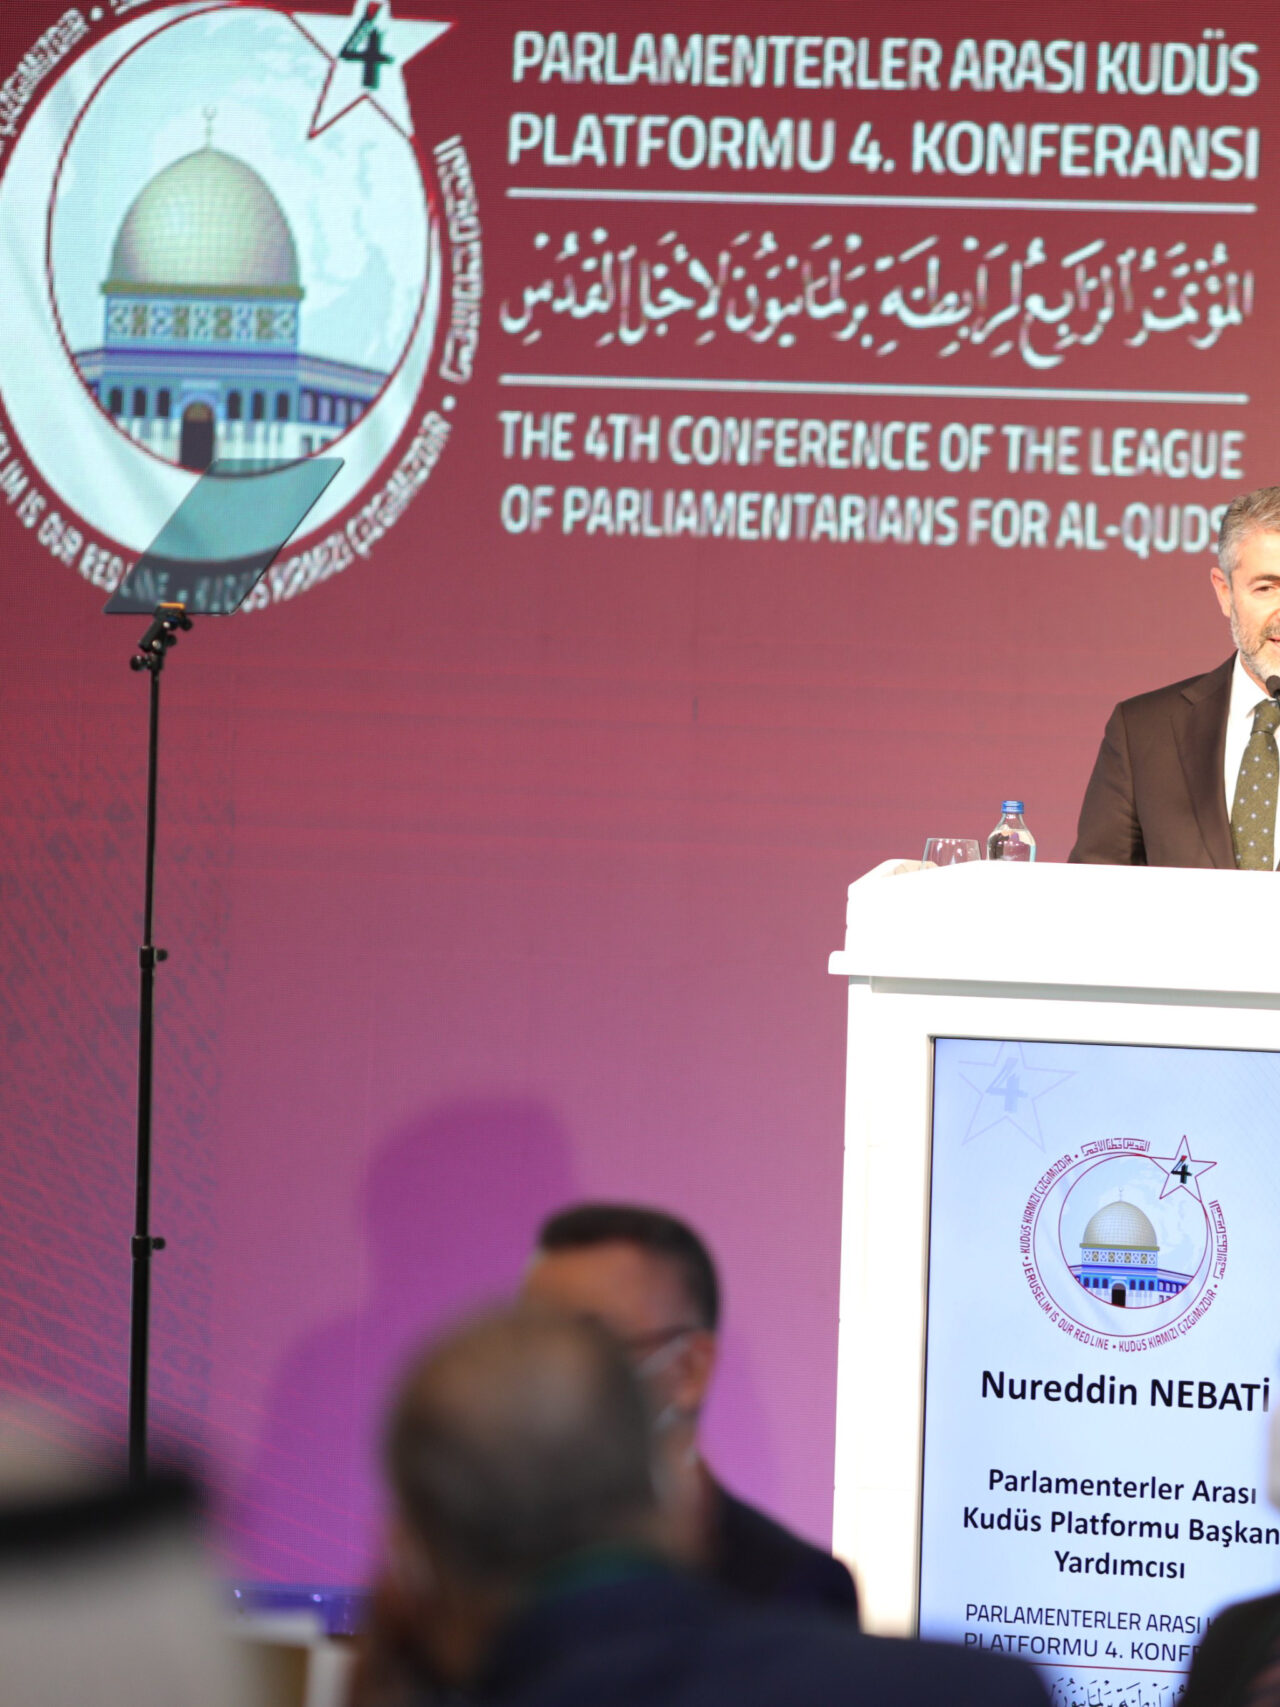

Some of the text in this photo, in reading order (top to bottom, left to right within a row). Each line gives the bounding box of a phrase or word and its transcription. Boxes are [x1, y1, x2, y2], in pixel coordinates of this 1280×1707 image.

[339, 2, 395, 91] 4
[511, 28, 1260, 96] PARLAMENTERLER ARASI KUDÜS
[507, 112, 1260, 180] PLATFORMU 4. KONFERANSI
[499, 410, 1245, 479] THE 4TH CONFERENCE OF THE LEAGUE
[501, 484, 555, 533] OF
[563, 487, 959, 546] PARLIAMENTARIANS
[968, 497, 1049, 547] FOR
[1170, 1154, 1193, 1184] 4
[1022, 1261, 1109, 1351] JERUSELIM IS OUR RED LINE
[981, 1370, 1271, 1413] Nureddin NEBATİ
[988, 1469, 1257, 1505] Parlamenterler Arası
[962, 1506, 1280, 1549] Kudüs Platformu Başkan
[1053, 1550, 1186, 1580] Yardımcısı
[965, 1603, 1142, 1632] PARLAMENTERLER
[1145, 1613, 1202, 1635] ARASI
[963, 1631, 1099, 1659] PLATFORMU
[1104, 1640, 1124, 1660] 4.
